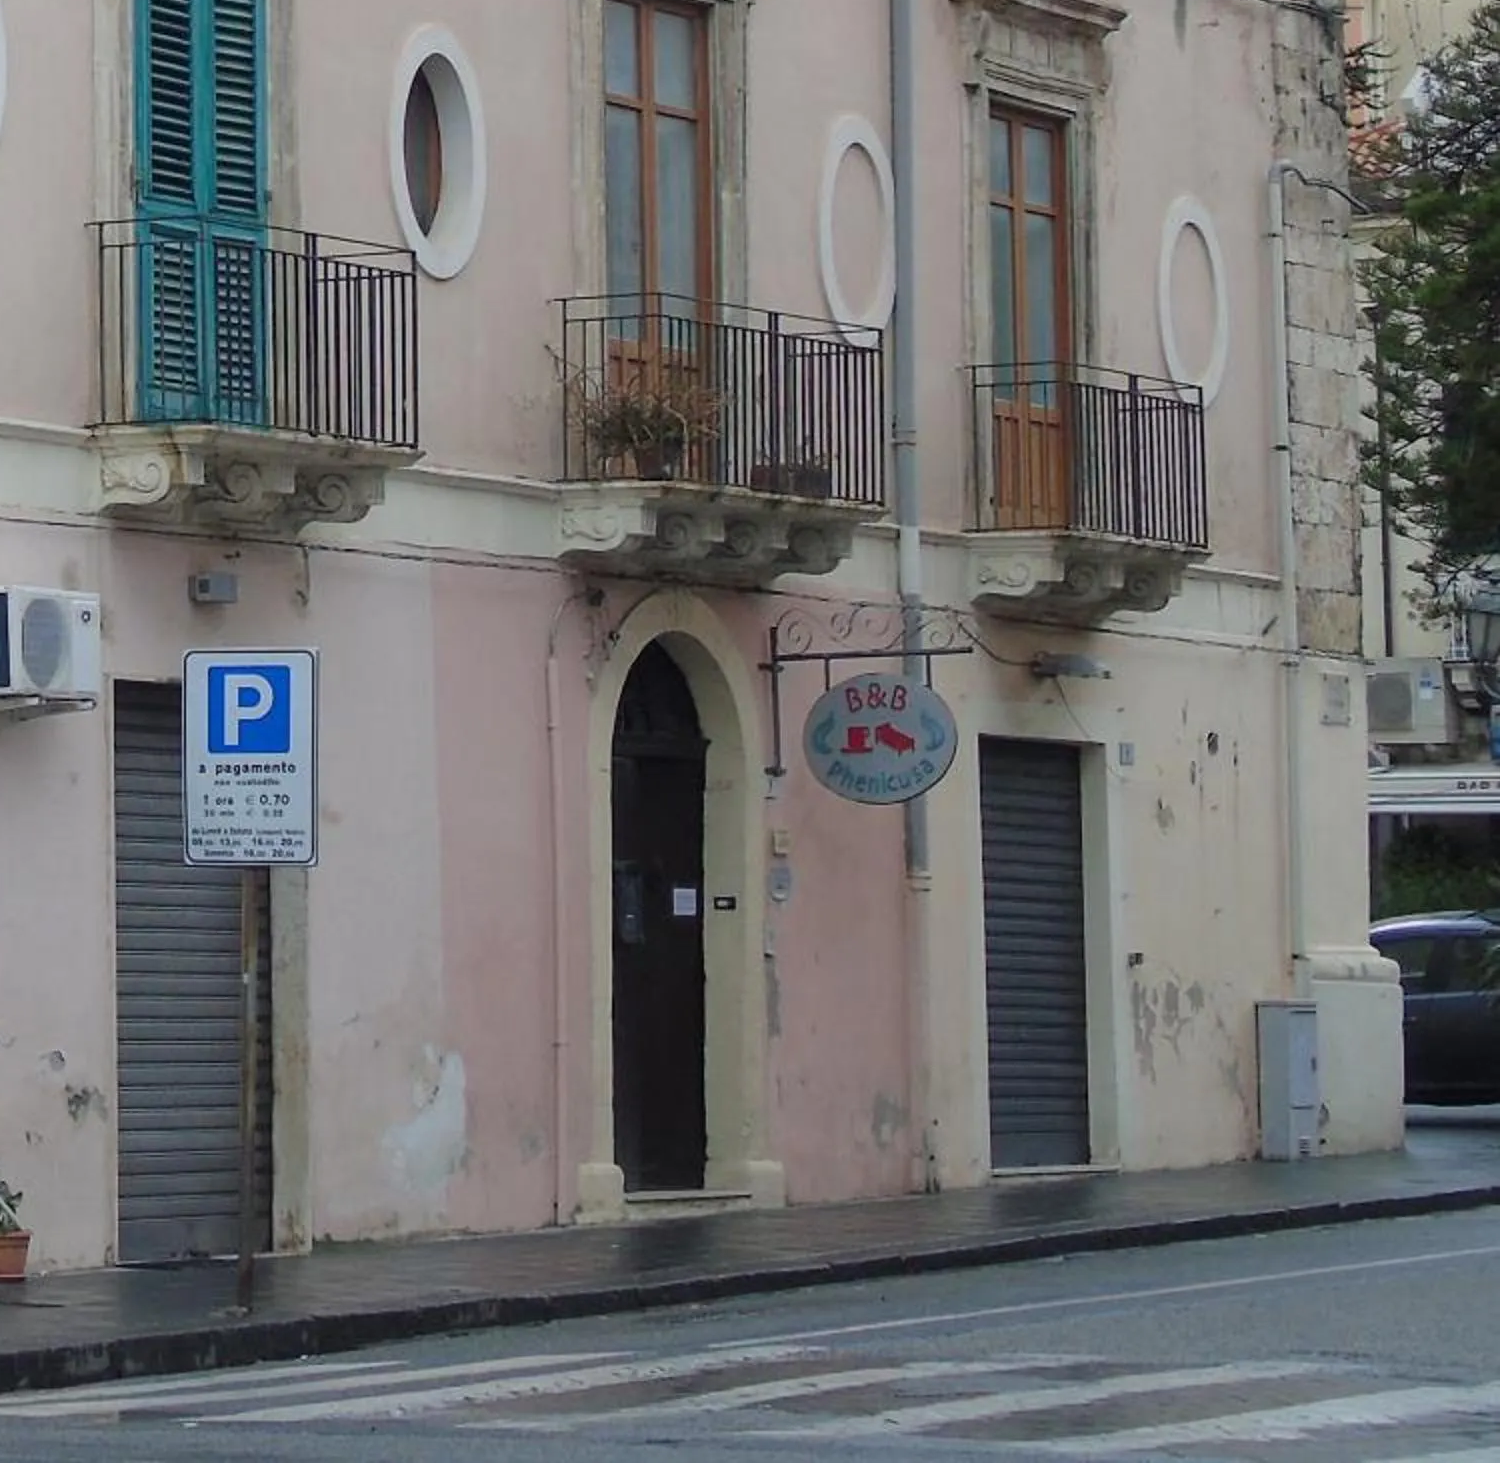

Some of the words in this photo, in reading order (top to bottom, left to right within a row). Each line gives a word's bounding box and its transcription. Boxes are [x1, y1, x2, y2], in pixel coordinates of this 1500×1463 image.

[224, 674, 274, 746] P
[845, 683, 907, 713] B&B
[198, 764, 207, 774] a
[215, 761, 297, 776] pagamento
[827, 759, 935, 794] Phenicusa
